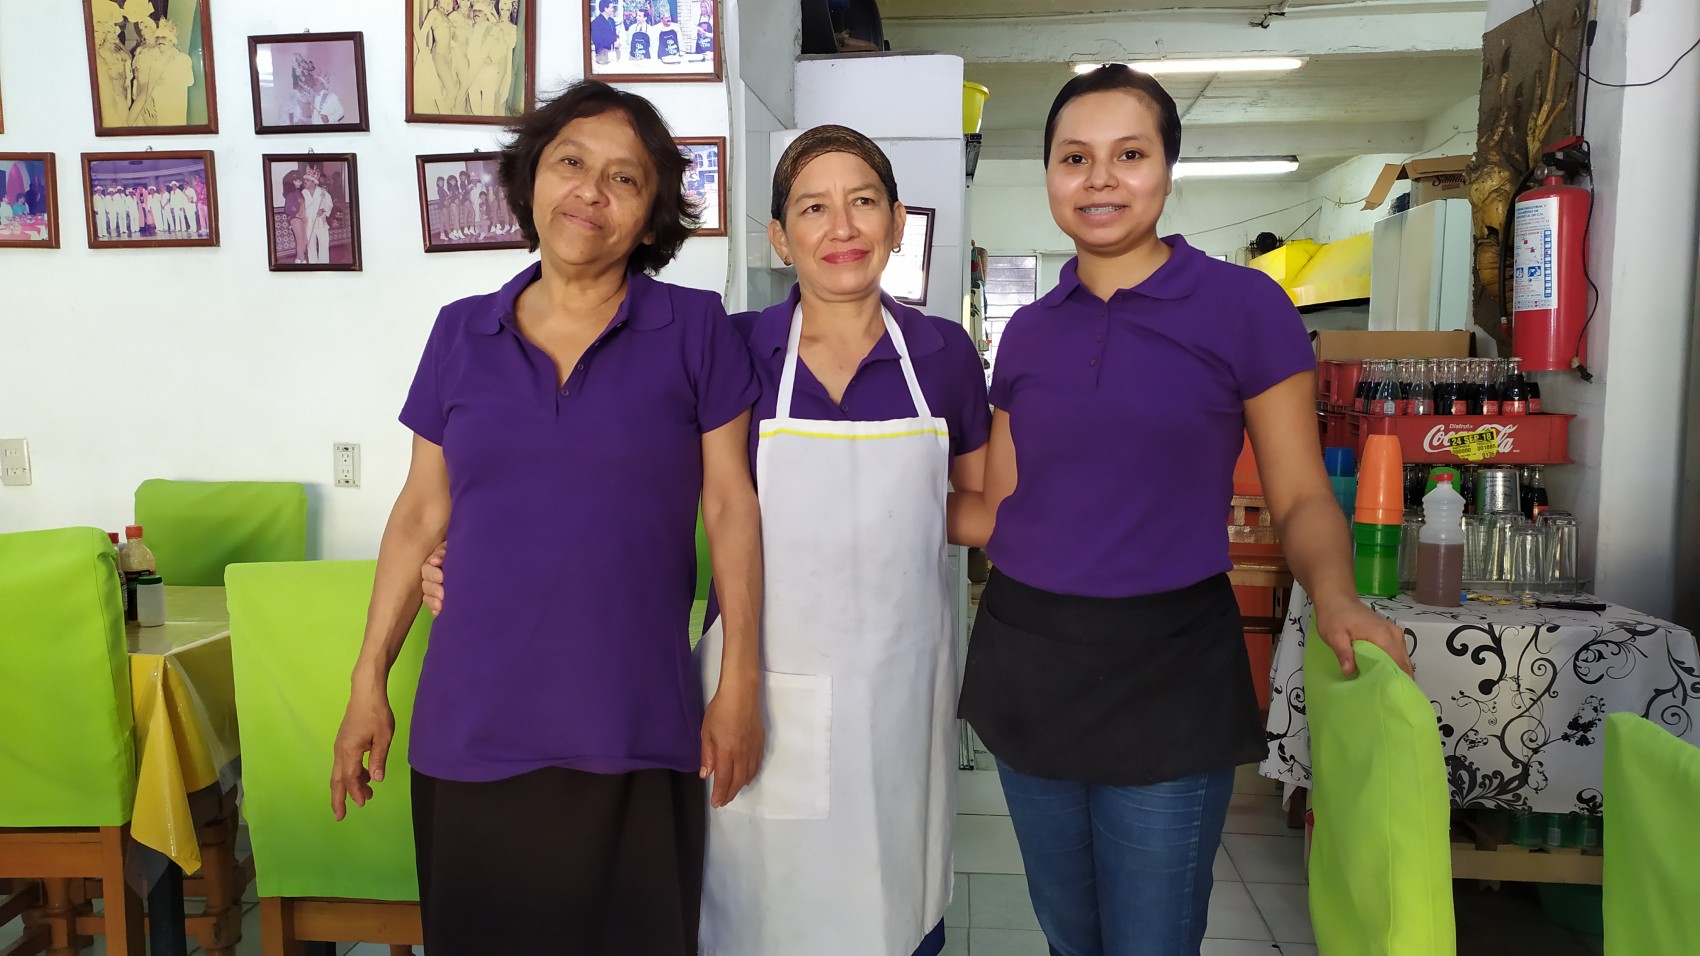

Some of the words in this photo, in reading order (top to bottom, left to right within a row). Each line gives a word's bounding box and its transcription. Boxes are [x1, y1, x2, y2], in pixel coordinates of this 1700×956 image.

[1423, 424, 1518, 453] Cocla
[1451, 438, 1462, 447] 24
[1464, 434, 1480, 444] SEP
[1482, 432, 1492, 442] 18
